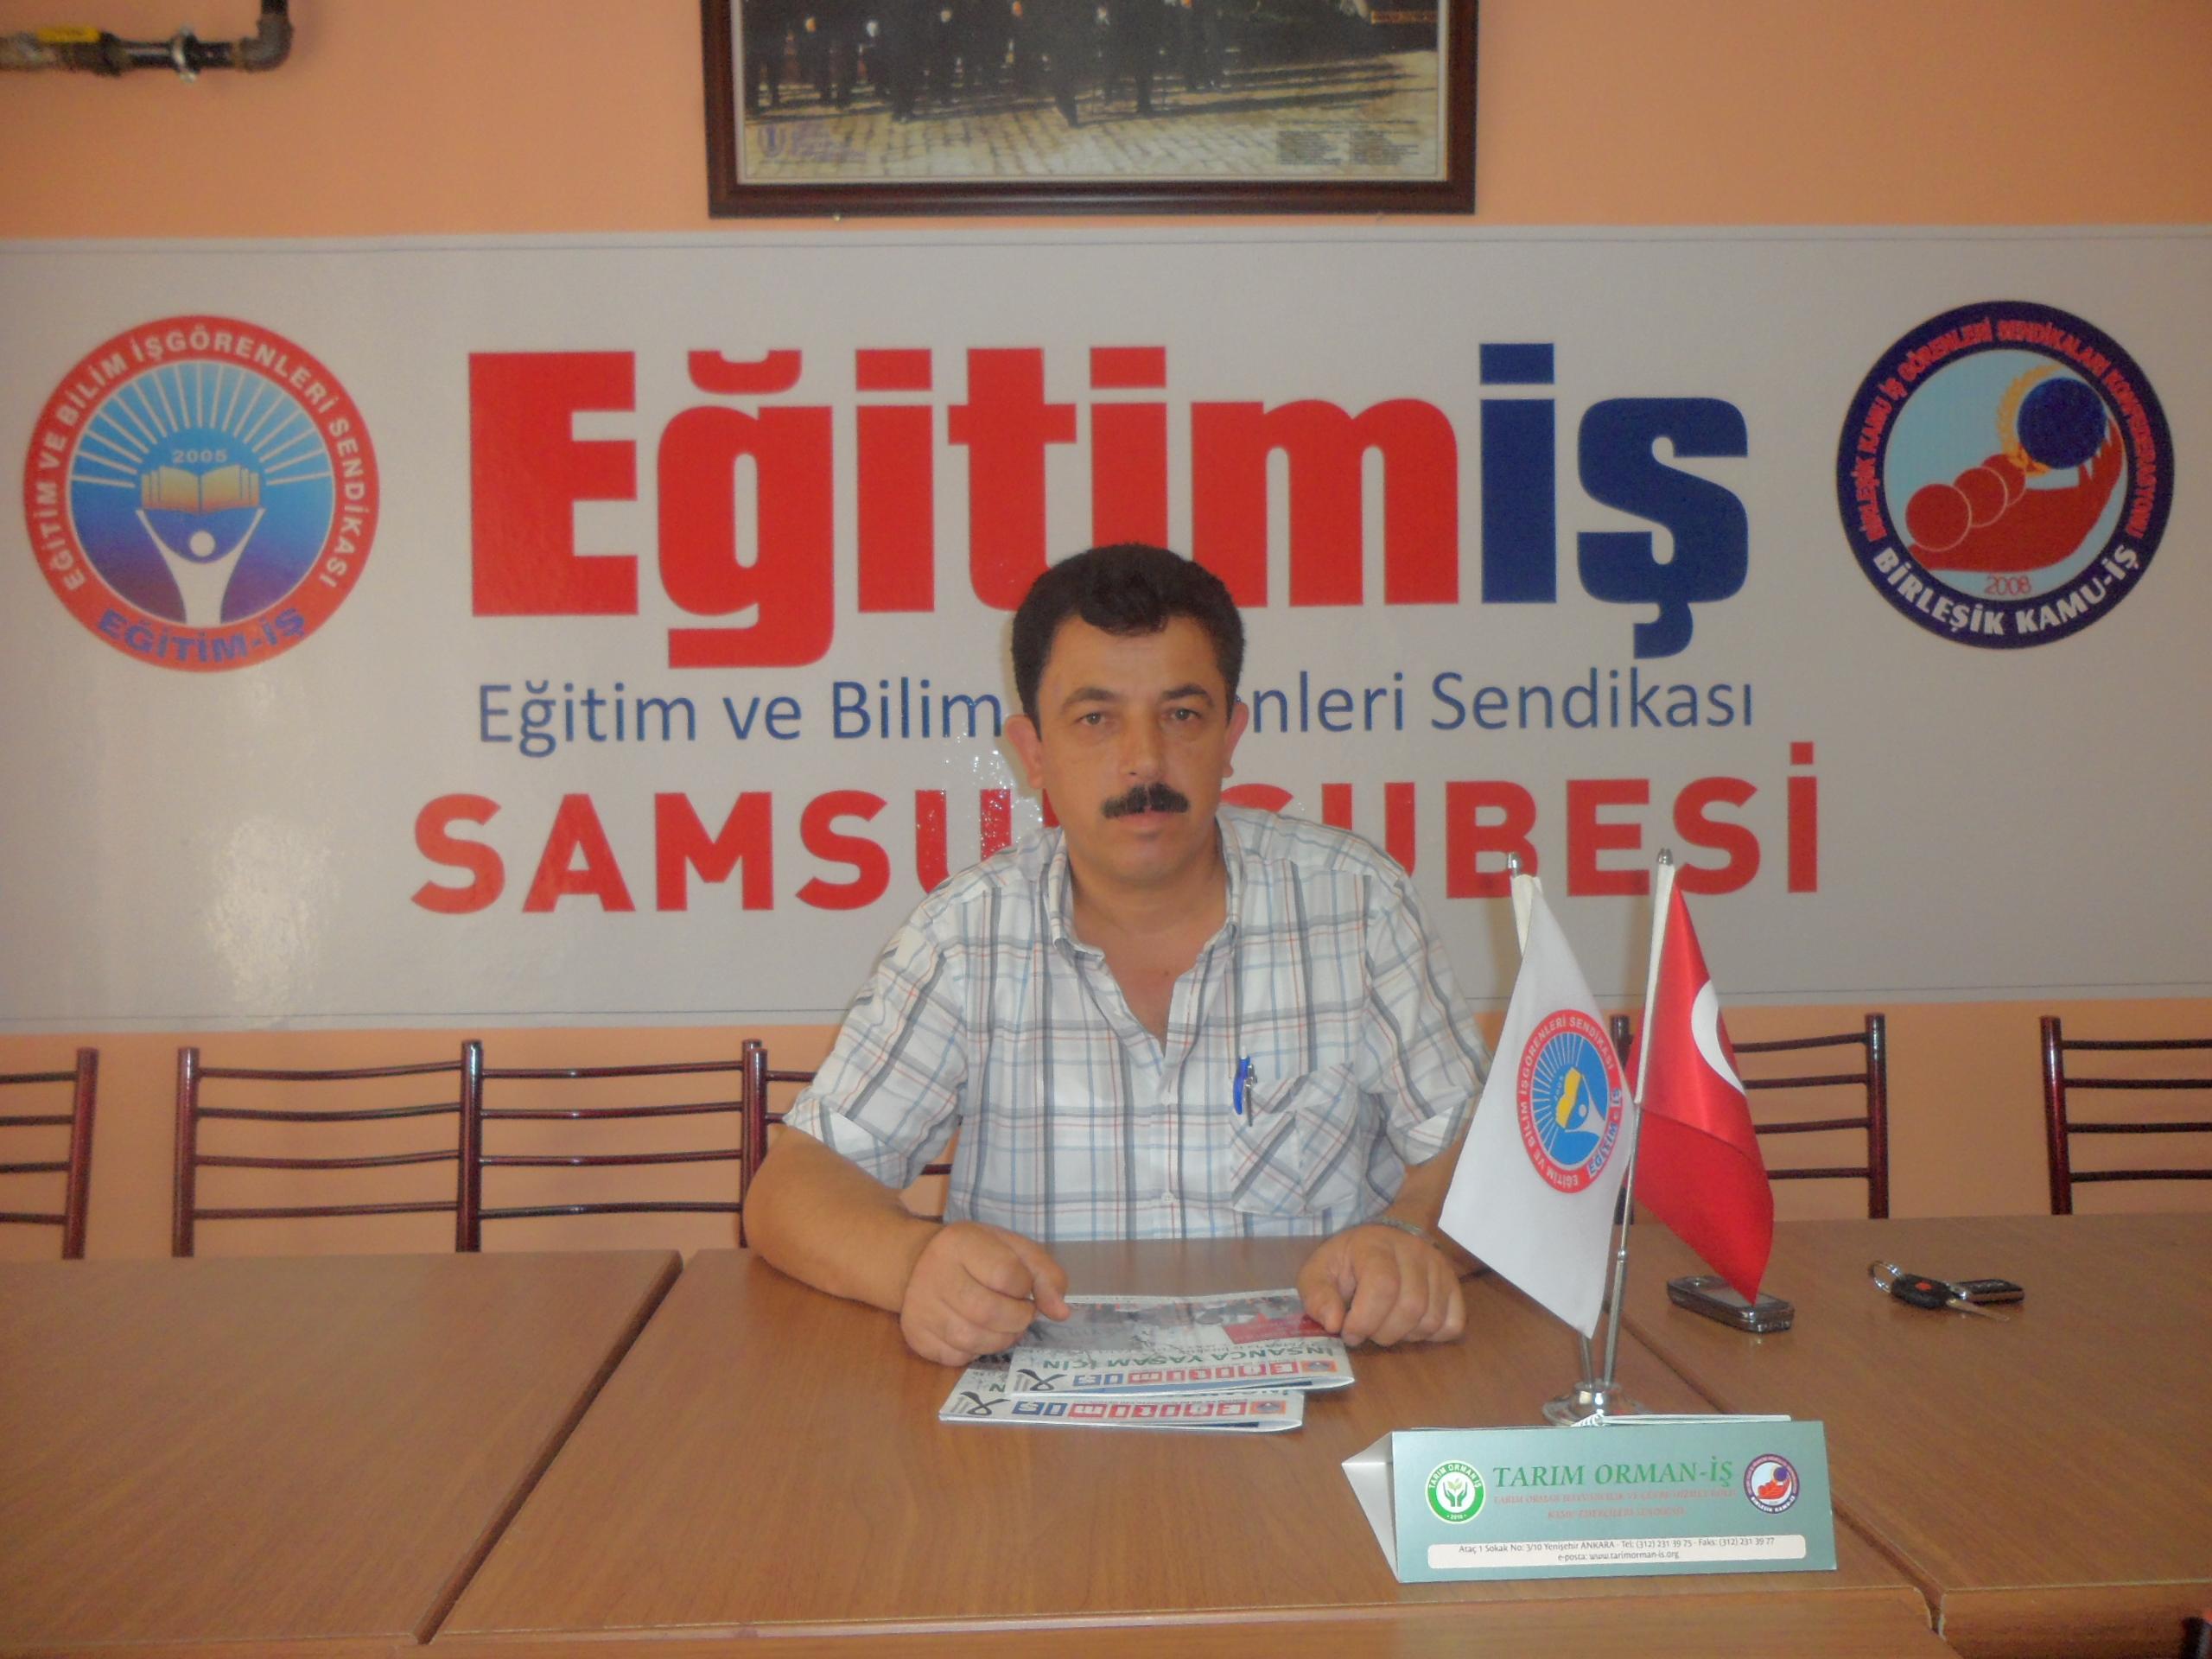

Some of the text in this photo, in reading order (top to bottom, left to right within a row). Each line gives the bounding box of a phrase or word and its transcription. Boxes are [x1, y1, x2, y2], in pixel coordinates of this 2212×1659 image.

[36, 323, 370, 593] EĞİTİM VE BİLİM İŞGÖRENLERİ SENDİKASI
[173, 449, 229, 464] 2005
[1872, 543, 2140, 637] BİRLEŞİK KAMU-İŞ
[1984, 575, 2032, 596] 2008
[96, 606, 308, 664] EĞİTİM-İŞ
[479, 677, 1003, 759] Eğitim ve Bilim
[1431, 667, 1754, 731] Sendikası
[410, 741, 1818, 915] SAMSU UBESİ
[1492, 1465, 1586, 1488] TARIM
[1594, 1455, 1734, 1487] ORMAN-İŞ
[1485, 1543, 1509, 1553] Sokak
[1580, 1541, 1615, 1550] ANKARA
[1636, 1539, 1656, 1549] (312)
[1657, 1539, 1670, 1548] 231
[1719, 1537, 1738, 1548] (312)
[1740, 1537, 1753, 1546] 231
